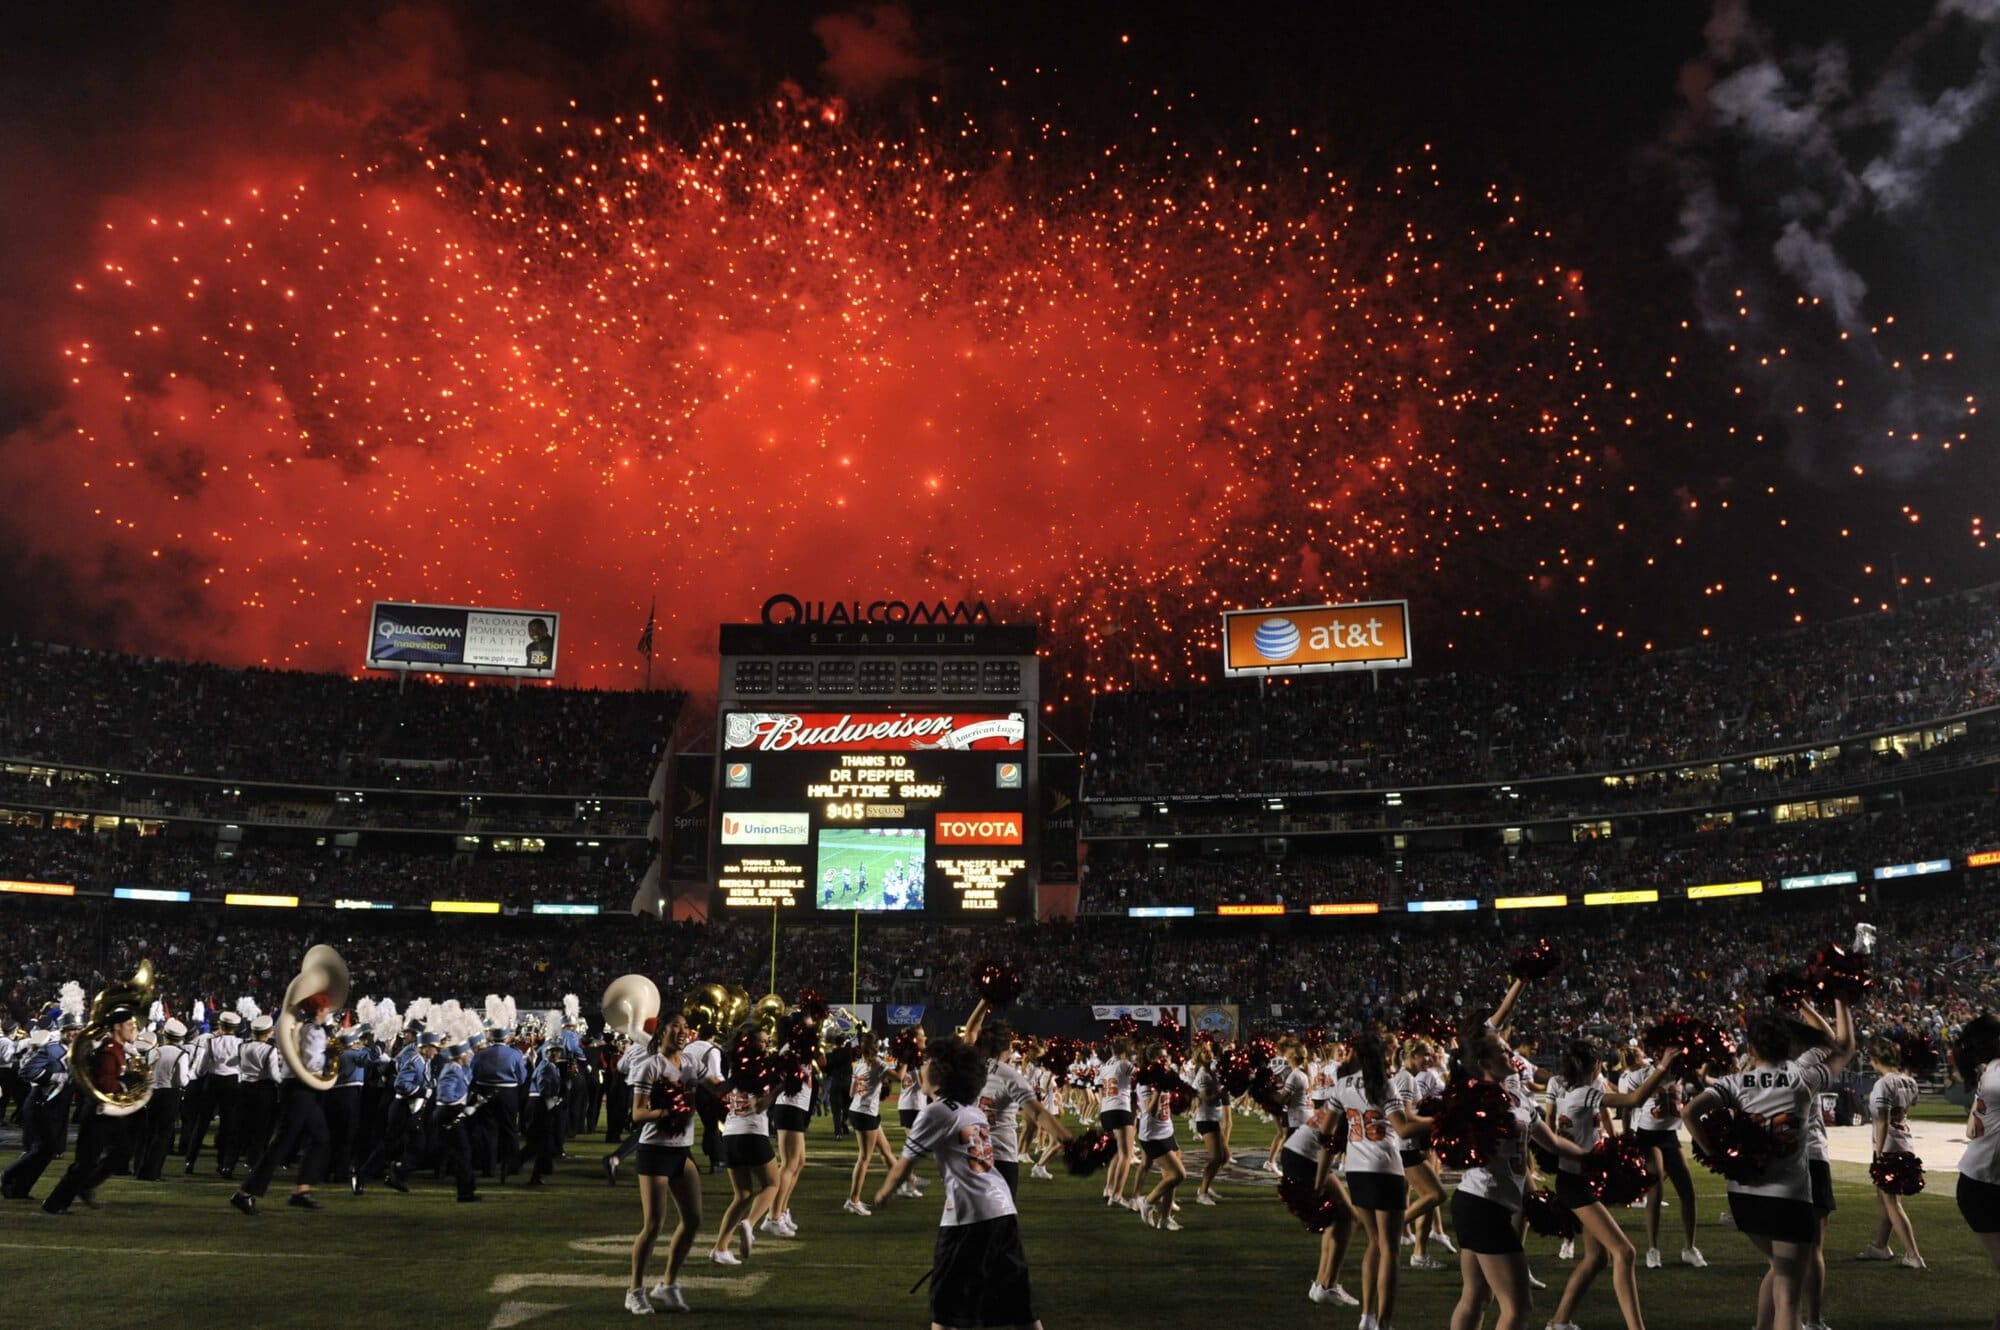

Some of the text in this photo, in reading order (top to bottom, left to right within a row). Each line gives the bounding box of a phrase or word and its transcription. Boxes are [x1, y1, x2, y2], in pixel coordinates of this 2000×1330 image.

[761, 593, 994, 632] QUALCOMM
[471, 616, 528, 628] PALOMAR
[379, 621, 461, 639] QUALCOMM
[470, 626, 526, 637] POMERADO
[1309, 617, 1383, 650] at&t
[469, 636, 526, 646] HEALTH
[810, 633, 976, 643] STADIUM
[394, 640, 447, 650] Innovation
[473, 655, 519, 664] www.pph.org
[752, 713, 951, 750] Budweiser
[956, 726, 994, 743] American
[841, 756, 906, 767] THANKS TO
[830, 769, 915, 782] DR PEPPER
[807, 785, 942, 797] HALFTIME SHOW
[826, 803, 864, 819] 9:05
[744, 824, 807, 834] UnionBank
[940, 822, 1018, 837] TOYOTA
[957, 860, 998, 868] PACIFIC
[1001, 860, 1025, 868] LIFE
[782, 897, 796, 906] CA
[1160, 1006, 1180, 1025] N
[1743, 1073, 1790, 1088] BGA
